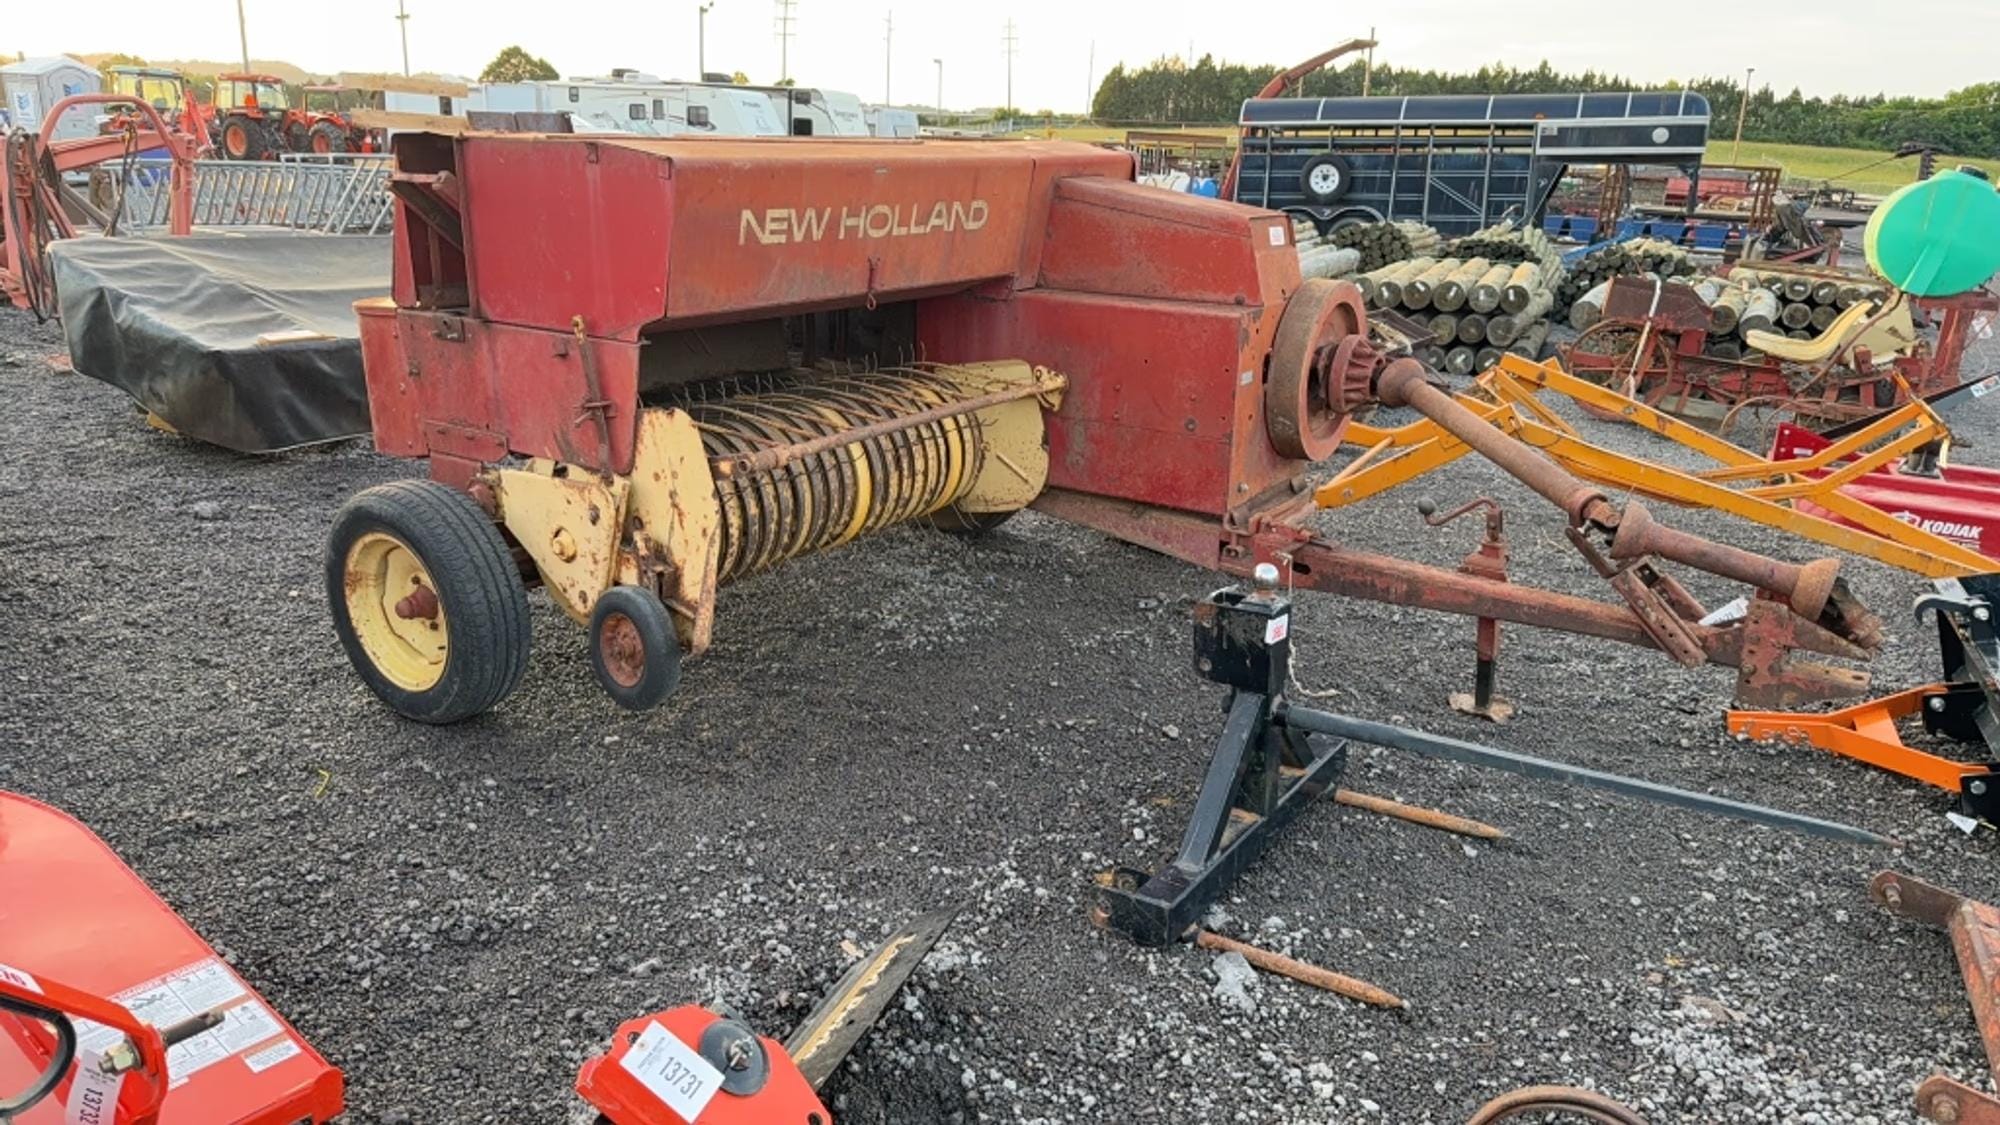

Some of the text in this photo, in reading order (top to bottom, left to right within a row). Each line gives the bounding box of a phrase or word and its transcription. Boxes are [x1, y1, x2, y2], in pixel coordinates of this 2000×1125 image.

[739, 200, 989, 246] NEW HOLLAND
[1921, 519, 1983, 539] KODIAK
[659, 1056, 703, 1099] 13731
[79, 1087, 103, 1124] 13732
